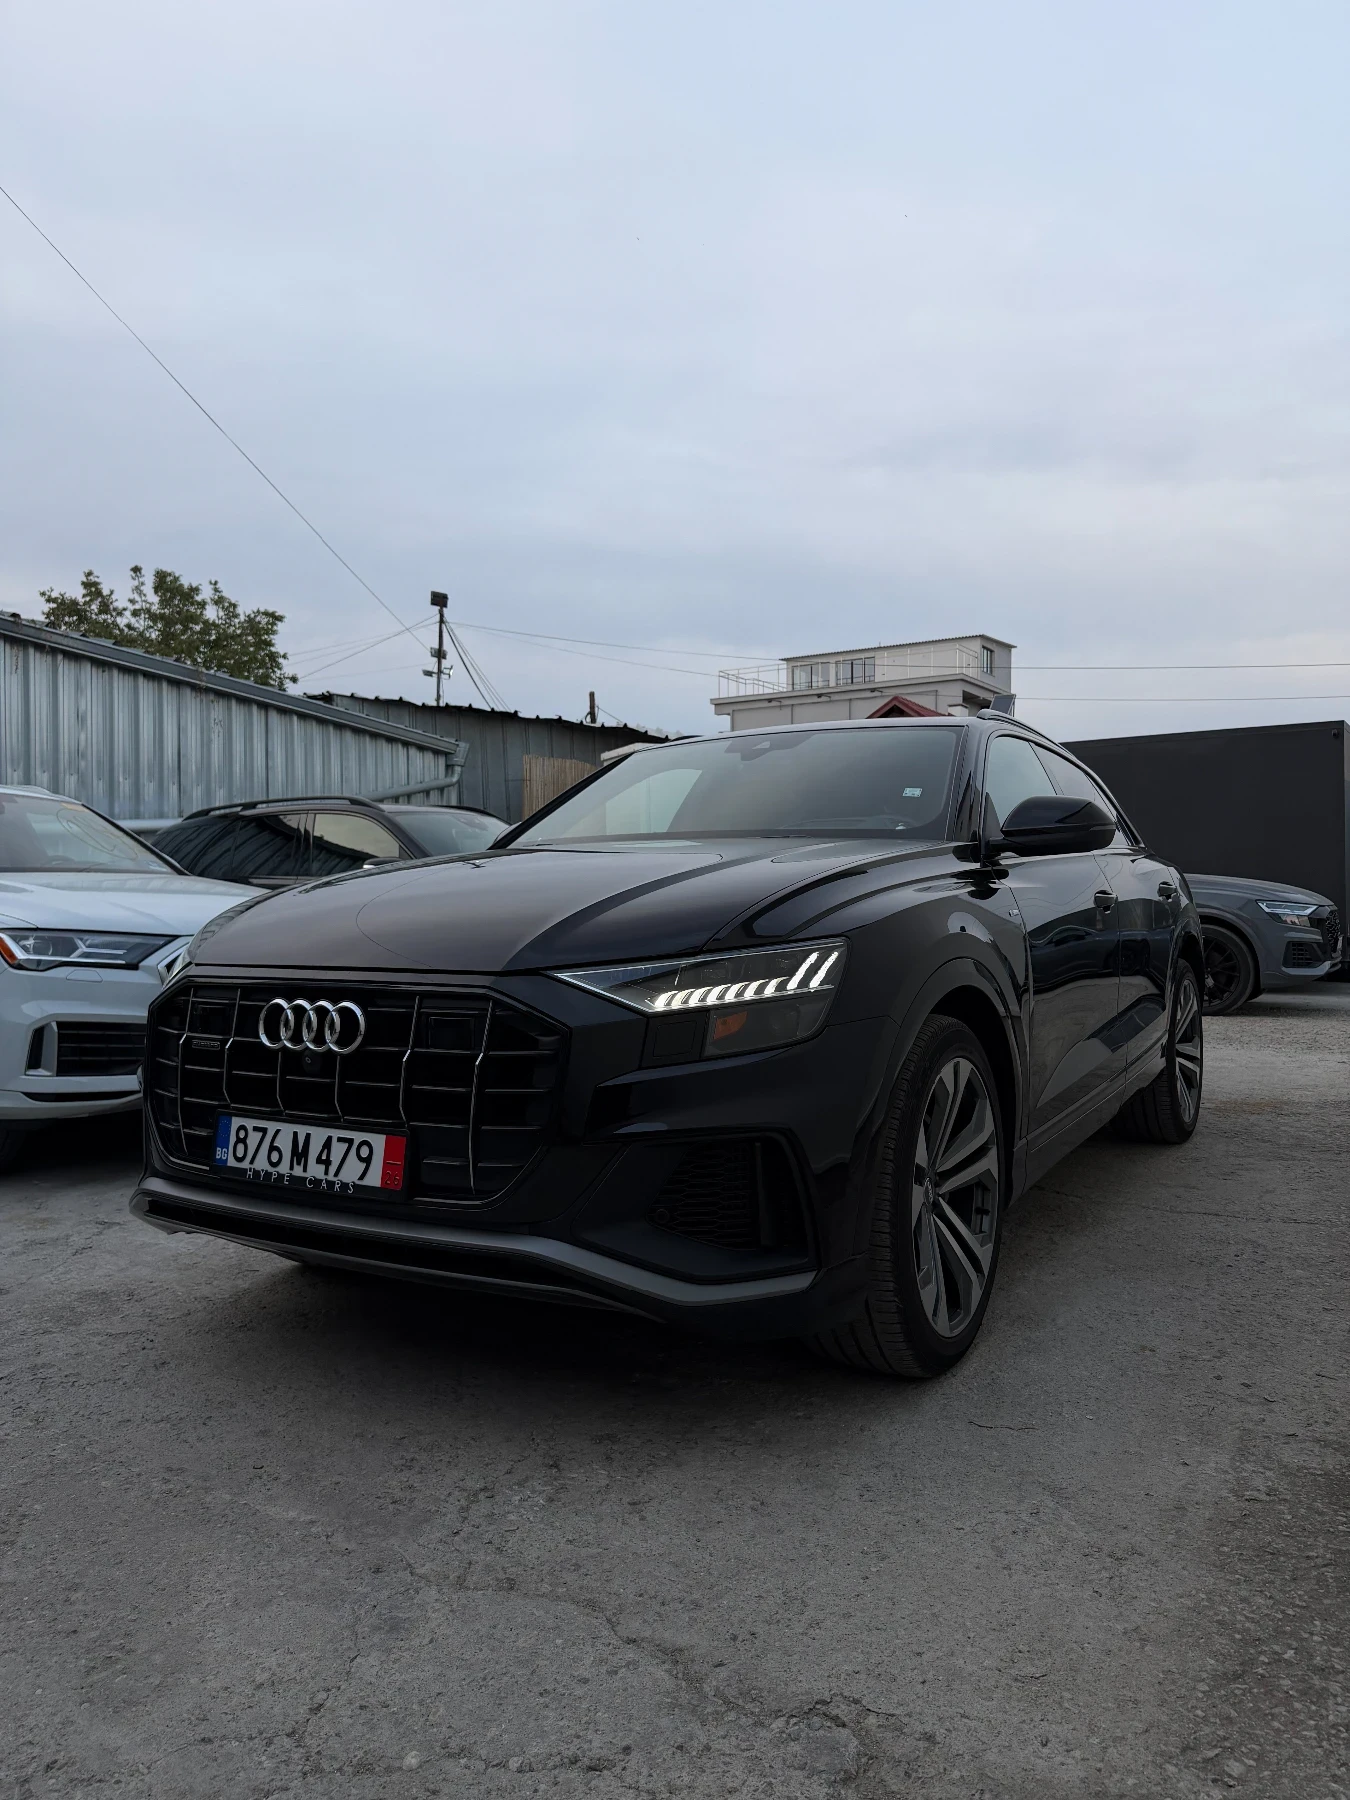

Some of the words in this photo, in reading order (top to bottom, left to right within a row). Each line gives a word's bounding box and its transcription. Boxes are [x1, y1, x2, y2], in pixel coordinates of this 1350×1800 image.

[215, 1147, 228, 1160] BG
[246, 1167, 290, 1185] HYPE
[306, 1176, 354, 1194] CARS
[384, 1170, 400, 1187] 26
